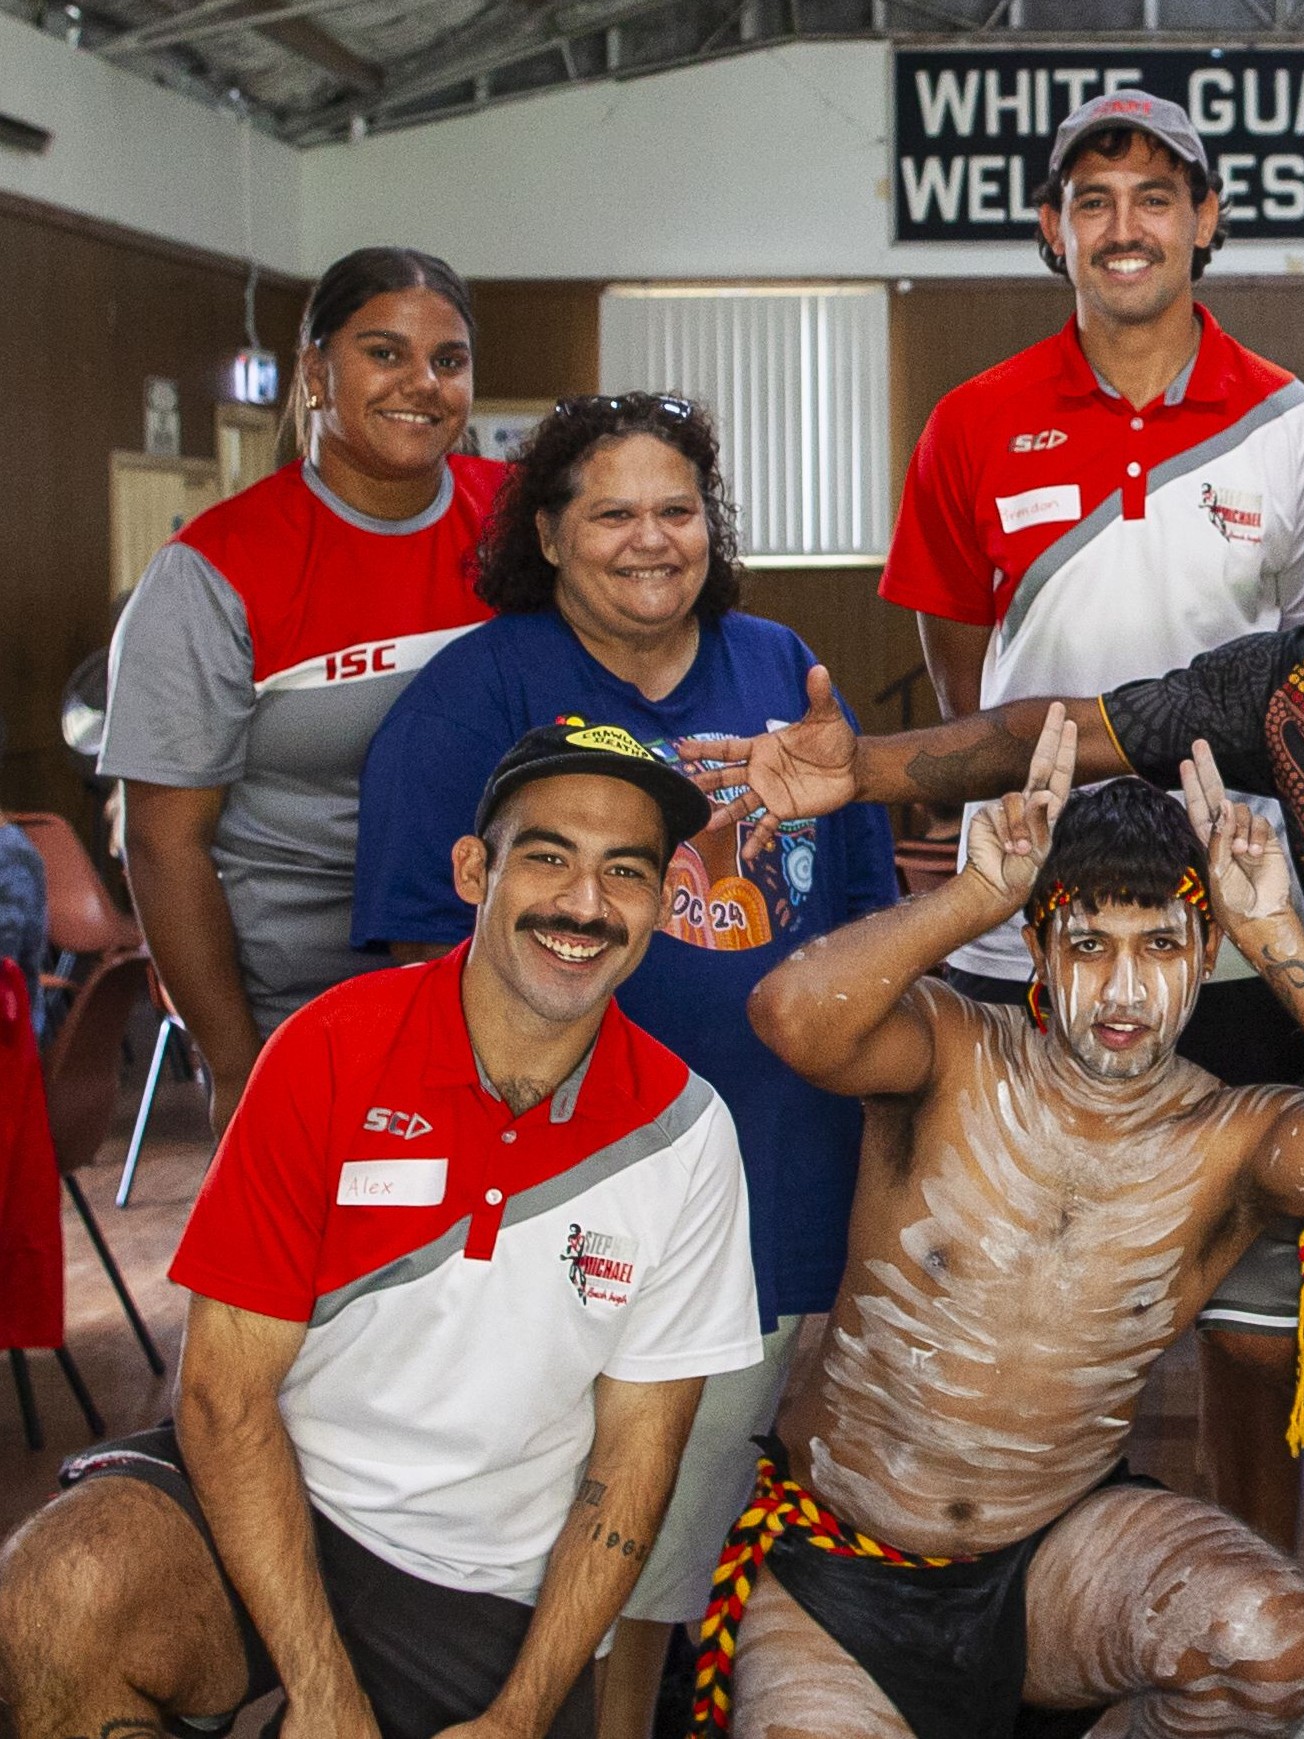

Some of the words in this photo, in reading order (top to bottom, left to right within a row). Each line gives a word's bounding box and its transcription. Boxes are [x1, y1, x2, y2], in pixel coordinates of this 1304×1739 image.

[326, 643, 396, 681] ISC
[711, 902, 744, 930] 24
[346, 1177, 394, 1197] Alex
[583, 1255, 633, 1284] MICHAEL
